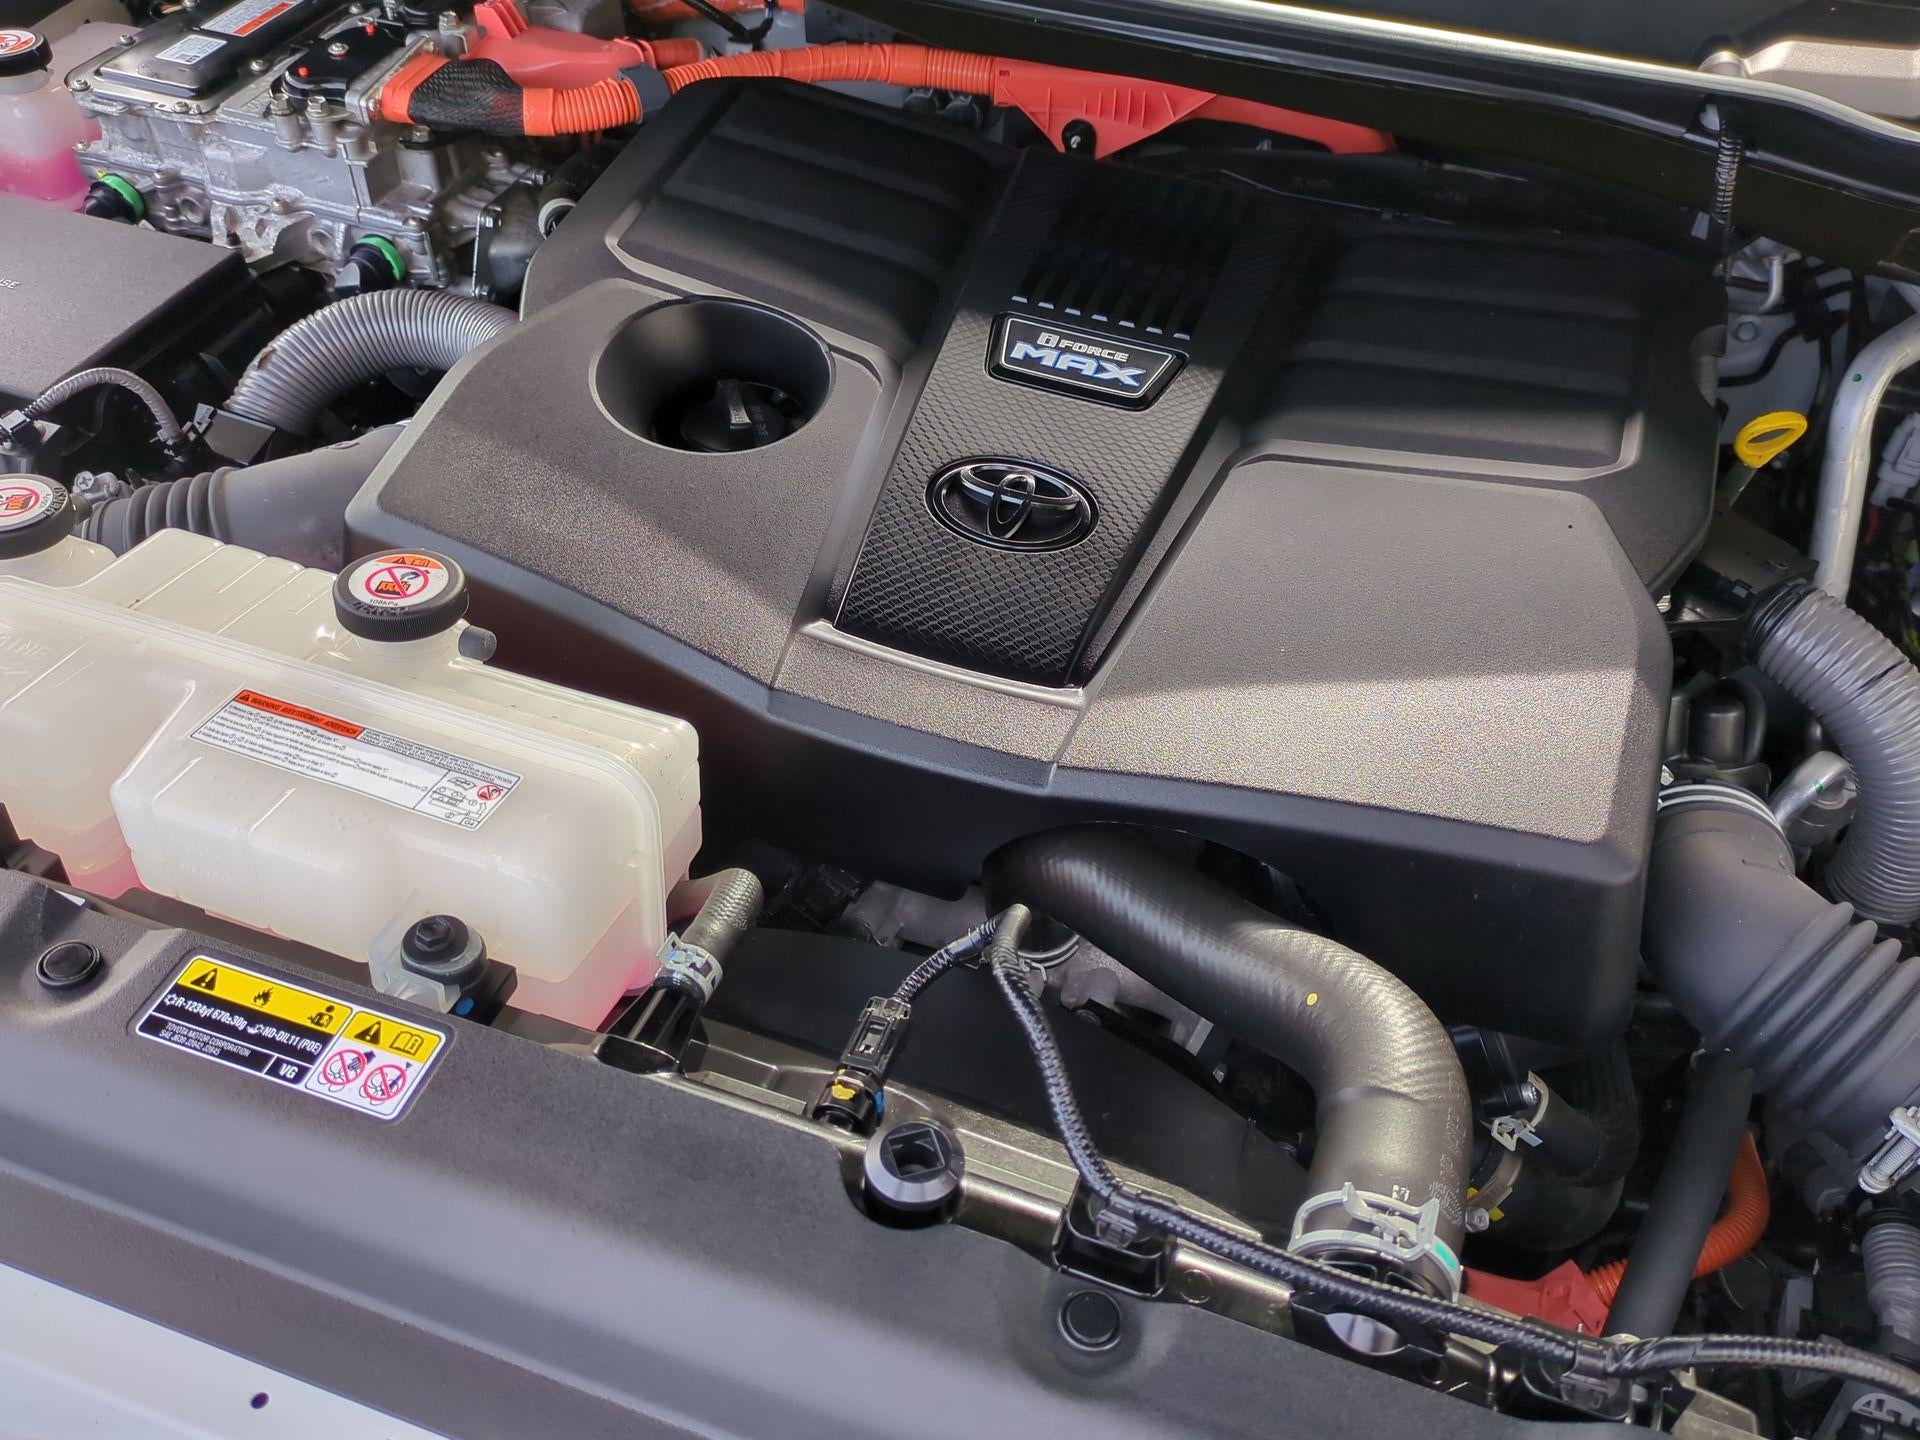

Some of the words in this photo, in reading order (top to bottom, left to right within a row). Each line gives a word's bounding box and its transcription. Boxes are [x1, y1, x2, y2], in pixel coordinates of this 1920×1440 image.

[1060, 339, 1130, 363] FORCE
[1009, 340, 1147, 387] MAX
[251, 697, 282, 711] WARNING
[165, 1022, 189, 1036] TOYOTA
[188, 1030, 210, 1043] MOTOR
[209, 1037, 251, 1057] CORPORATION
[278, 1063, 299, 1079] VG
